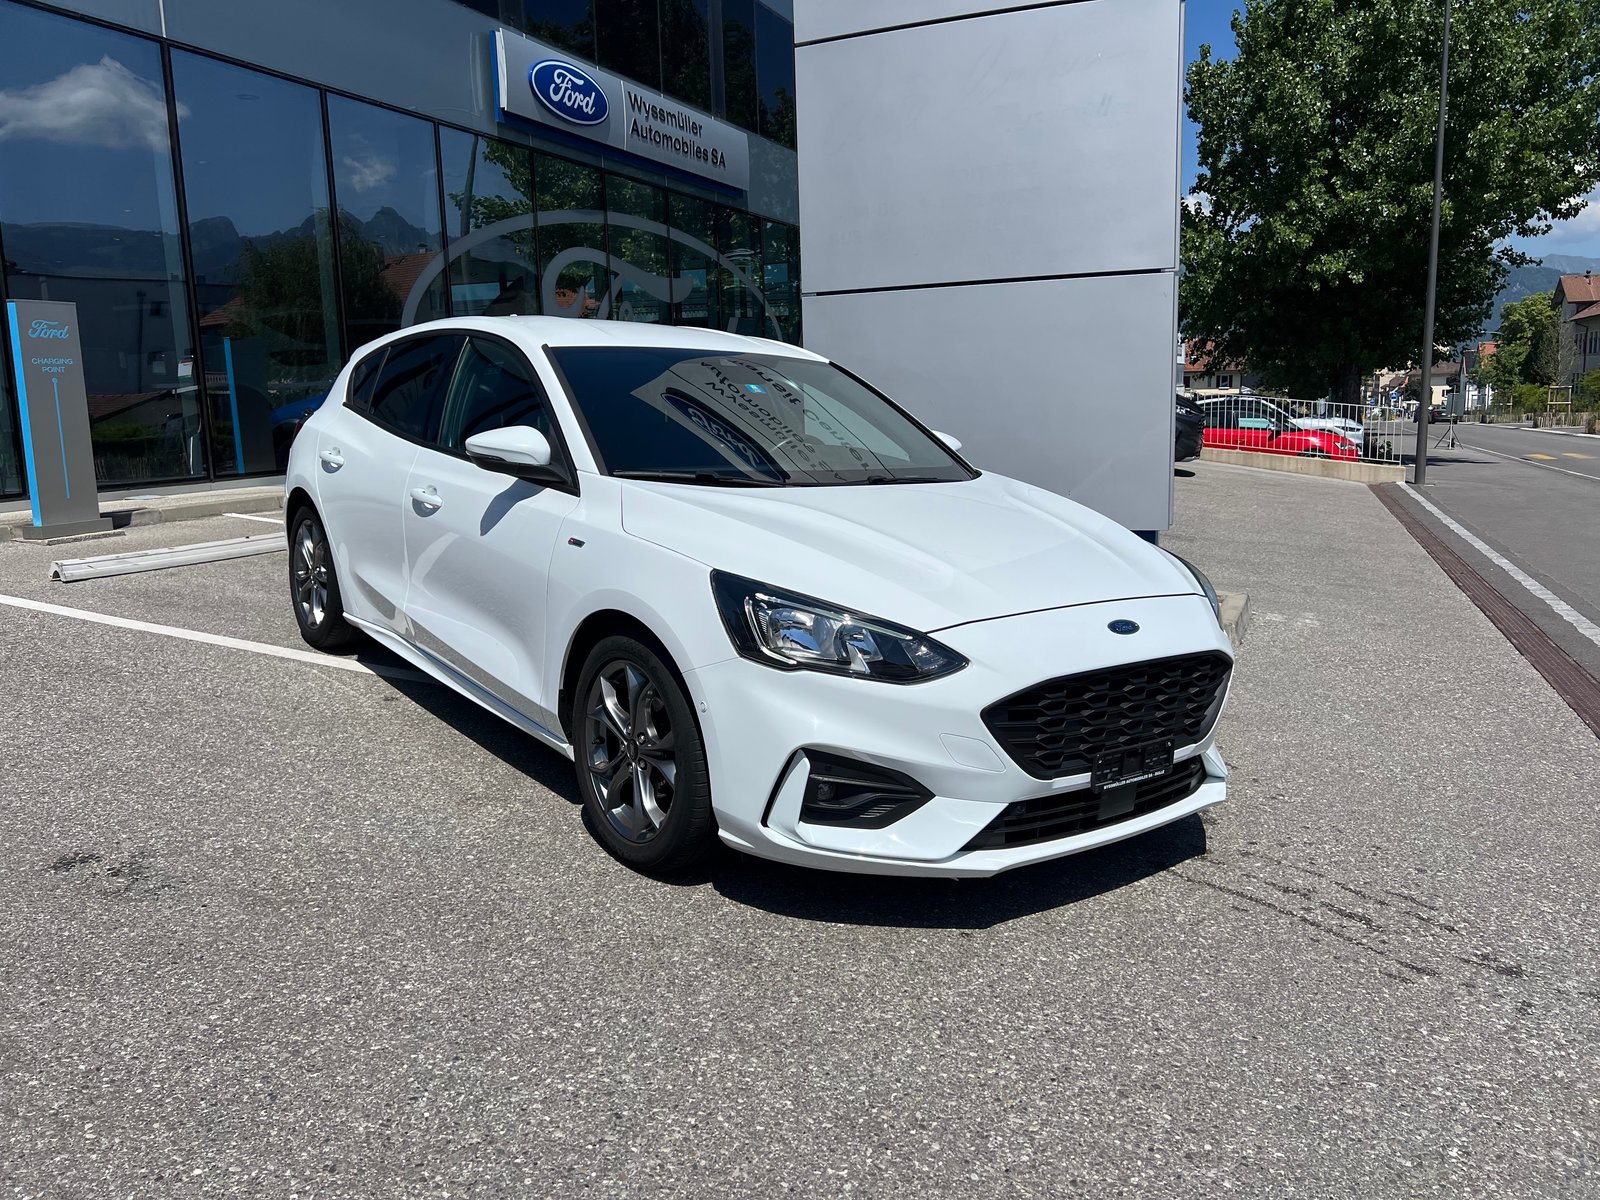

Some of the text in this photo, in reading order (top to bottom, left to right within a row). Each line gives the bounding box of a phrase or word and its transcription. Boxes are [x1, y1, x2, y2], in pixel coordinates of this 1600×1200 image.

[550, 68, 597, 115] Ford
[627, 91, 703, 138] Wyssmüller
[629, 118, 726, 168] Automobiles SA
[28, 319, 70, 339] Ford
[31, 357, 73, 365] CHARGING
